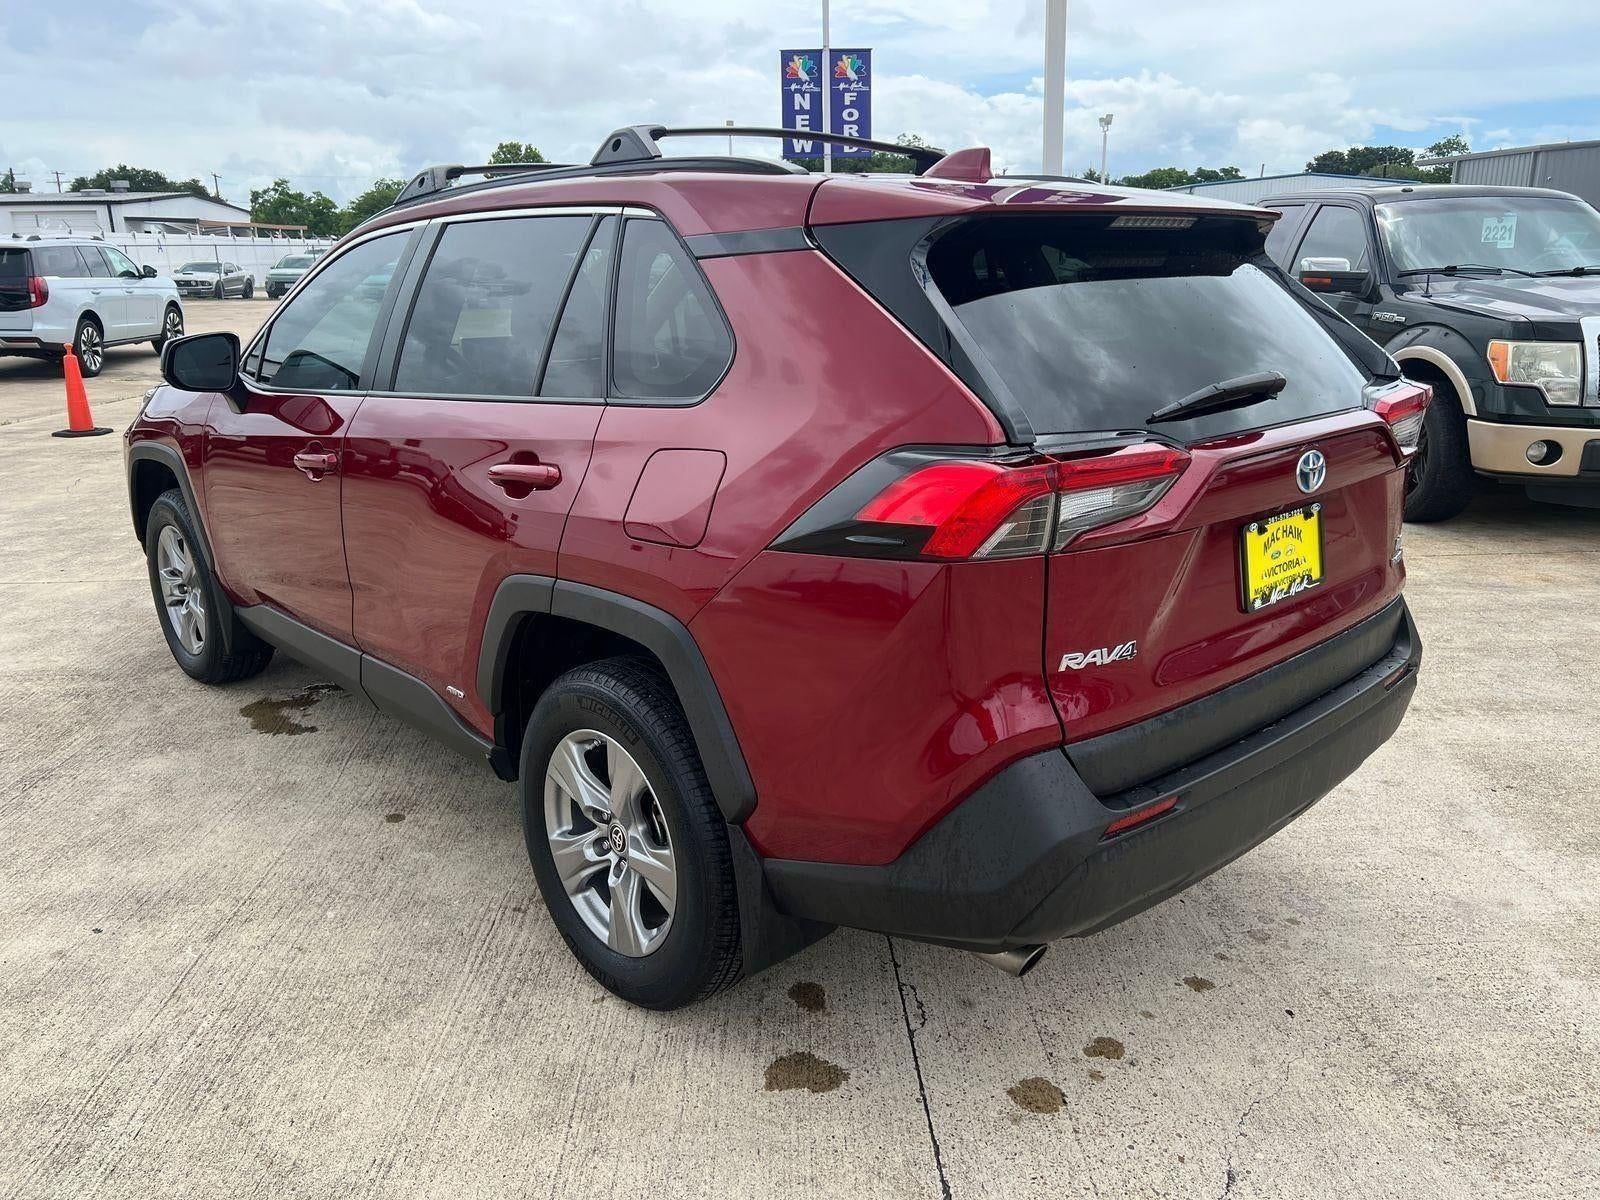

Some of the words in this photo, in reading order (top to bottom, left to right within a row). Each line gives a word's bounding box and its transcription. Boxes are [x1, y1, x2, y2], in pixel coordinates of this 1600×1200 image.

[793, 93, 813, 153] NEW
[1484, 223, 1513, 241] 2221
[1263, 527, 1281, 556] MAC
[1282, 524, 1303, 544] HAIK
[1269, 586, 1290, 605] Mac
[1289, 575, 1320, 596] Haik
[1058, 640, 1137, 672] RAV4
